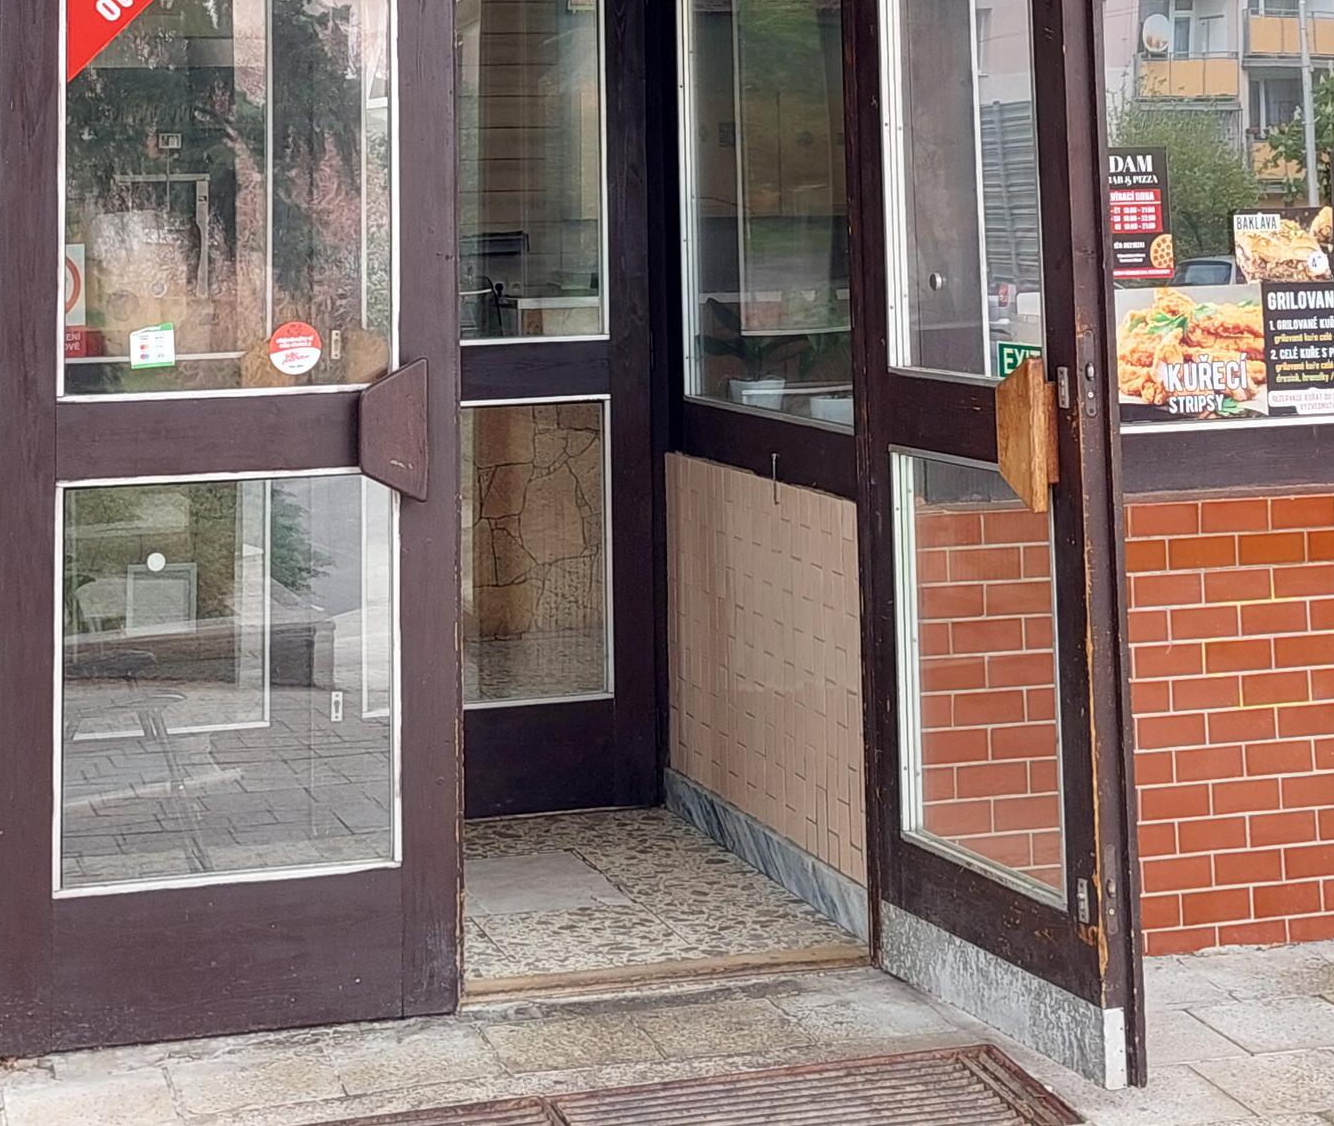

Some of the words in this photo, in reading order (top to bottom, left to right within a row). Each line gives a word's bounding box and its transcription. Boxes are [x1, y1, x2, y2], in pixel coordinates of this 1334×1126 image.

[1109, 155, 1153, 173] DAM
[1237, 217, 1277, 230] BAKLAVA
[1277, 316, 1318, 330] GRILOVANÉ
[1003, 347, 1041, 374] EX
[1280, 346, 1298, 359] CELÉ
[1300, 346, 1320, 358] KUŘE
[1168, 353, 1248, 392] KUŘECÍ
[1169, 394, 1224, 414] STRIPSY
